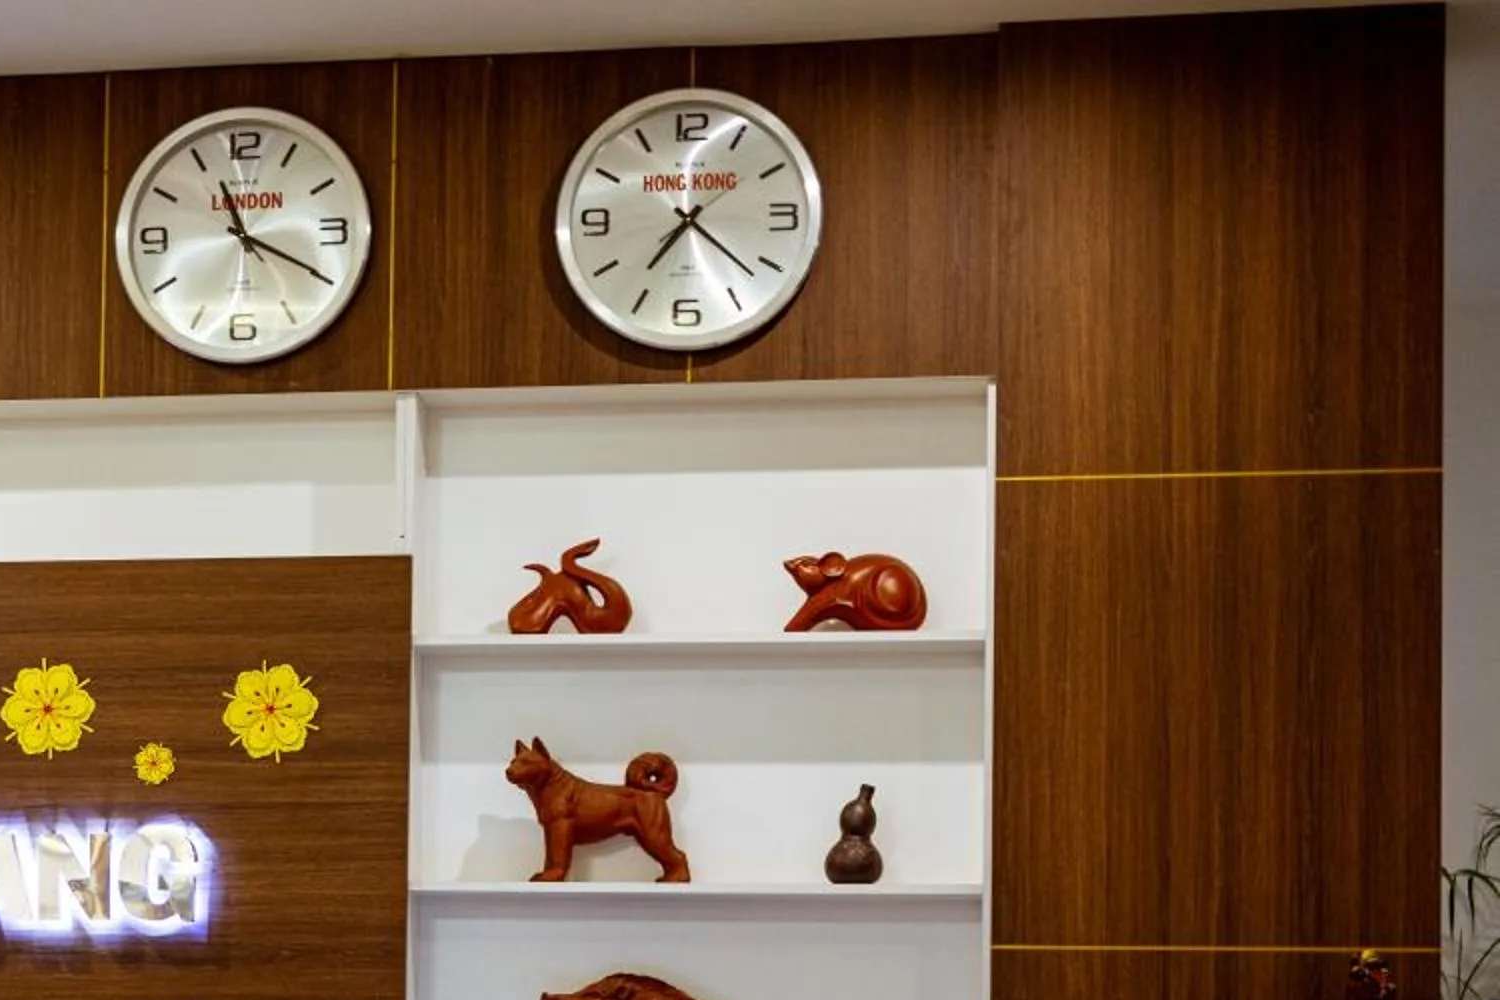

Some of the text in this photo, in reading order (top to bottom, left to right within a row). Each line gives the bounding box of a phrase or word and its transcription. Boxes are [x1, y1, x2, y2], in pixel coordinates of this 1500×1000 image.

[676, 113, 709, 142] 12
[229, 132, 261, 160] 12
[643, 172, 737, 192] HONG KONG
[319, 217, 348, 246] 3
[581, 208, 610, 236] 9
[769, 203, 799, 232] 3
[140, 227, 168, 254] 9
[672, 299, 702, 327] 6
[229, 314, 257, 341] 6
